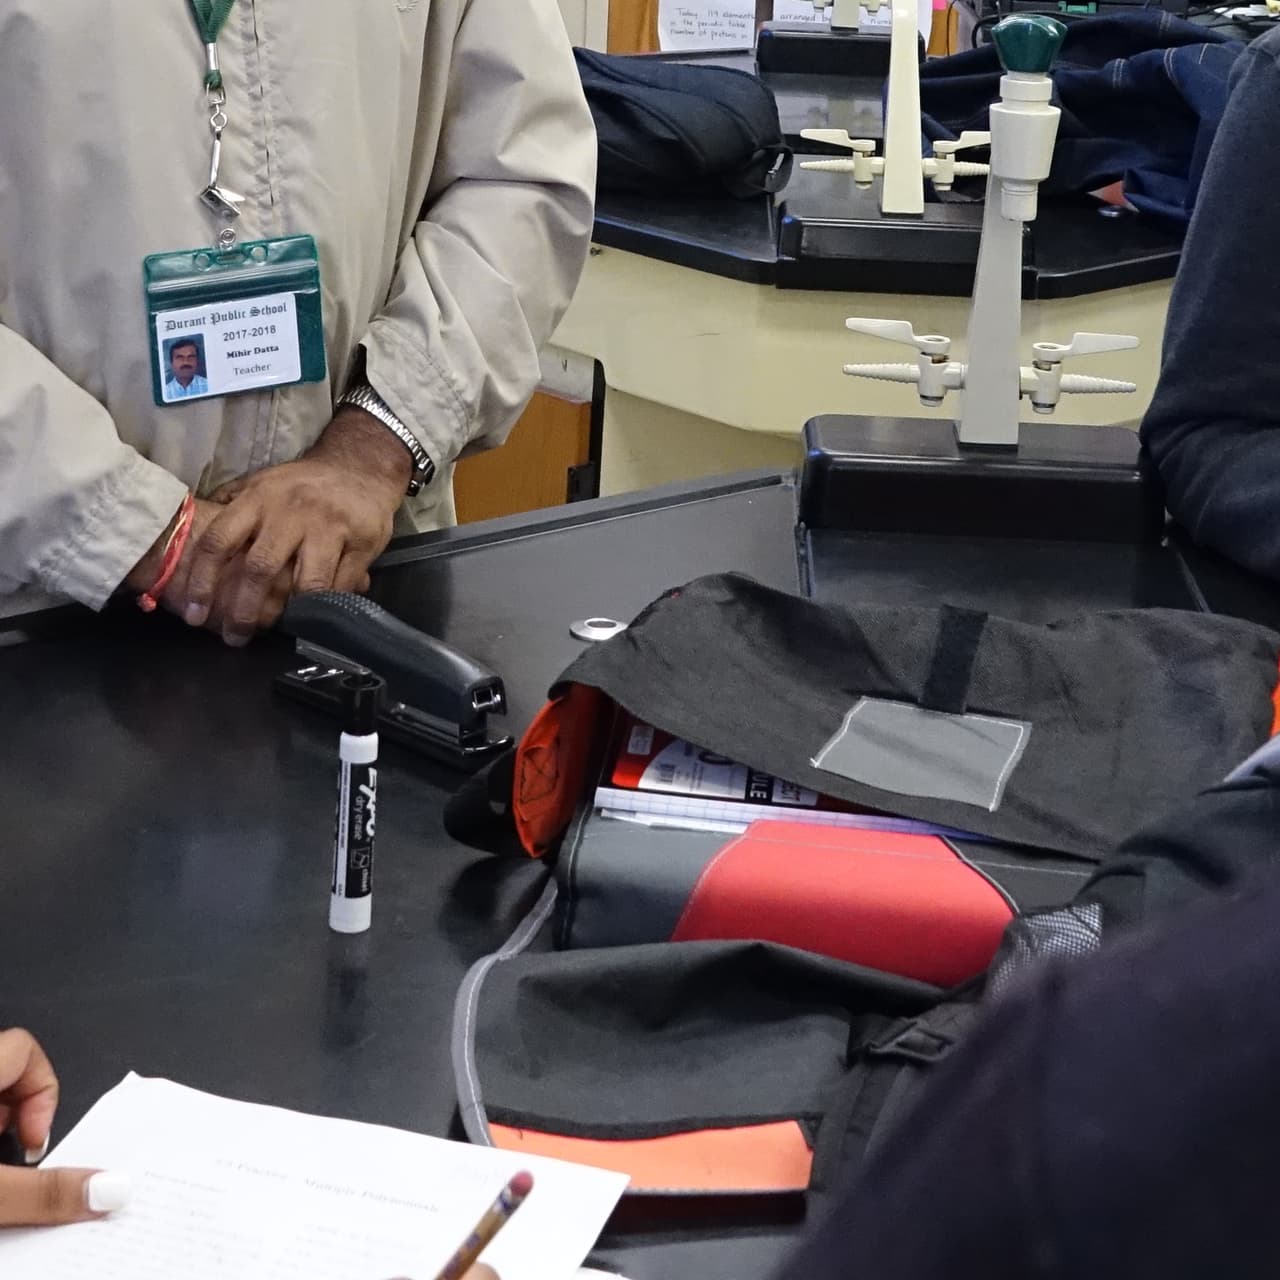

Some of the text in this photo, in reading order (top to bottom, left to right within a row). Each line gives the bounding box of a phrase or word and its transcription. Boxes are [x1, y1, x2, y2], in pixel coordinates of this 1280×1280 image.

[164, 302, 287, 332] Durant Public School
[223, 325, 277, 342] 2017-2018
[226, 344, 280, 360] Mihir Datta
[232, 363, 271, 376] Teacher
[353, 795, 364, 841] dry erase
